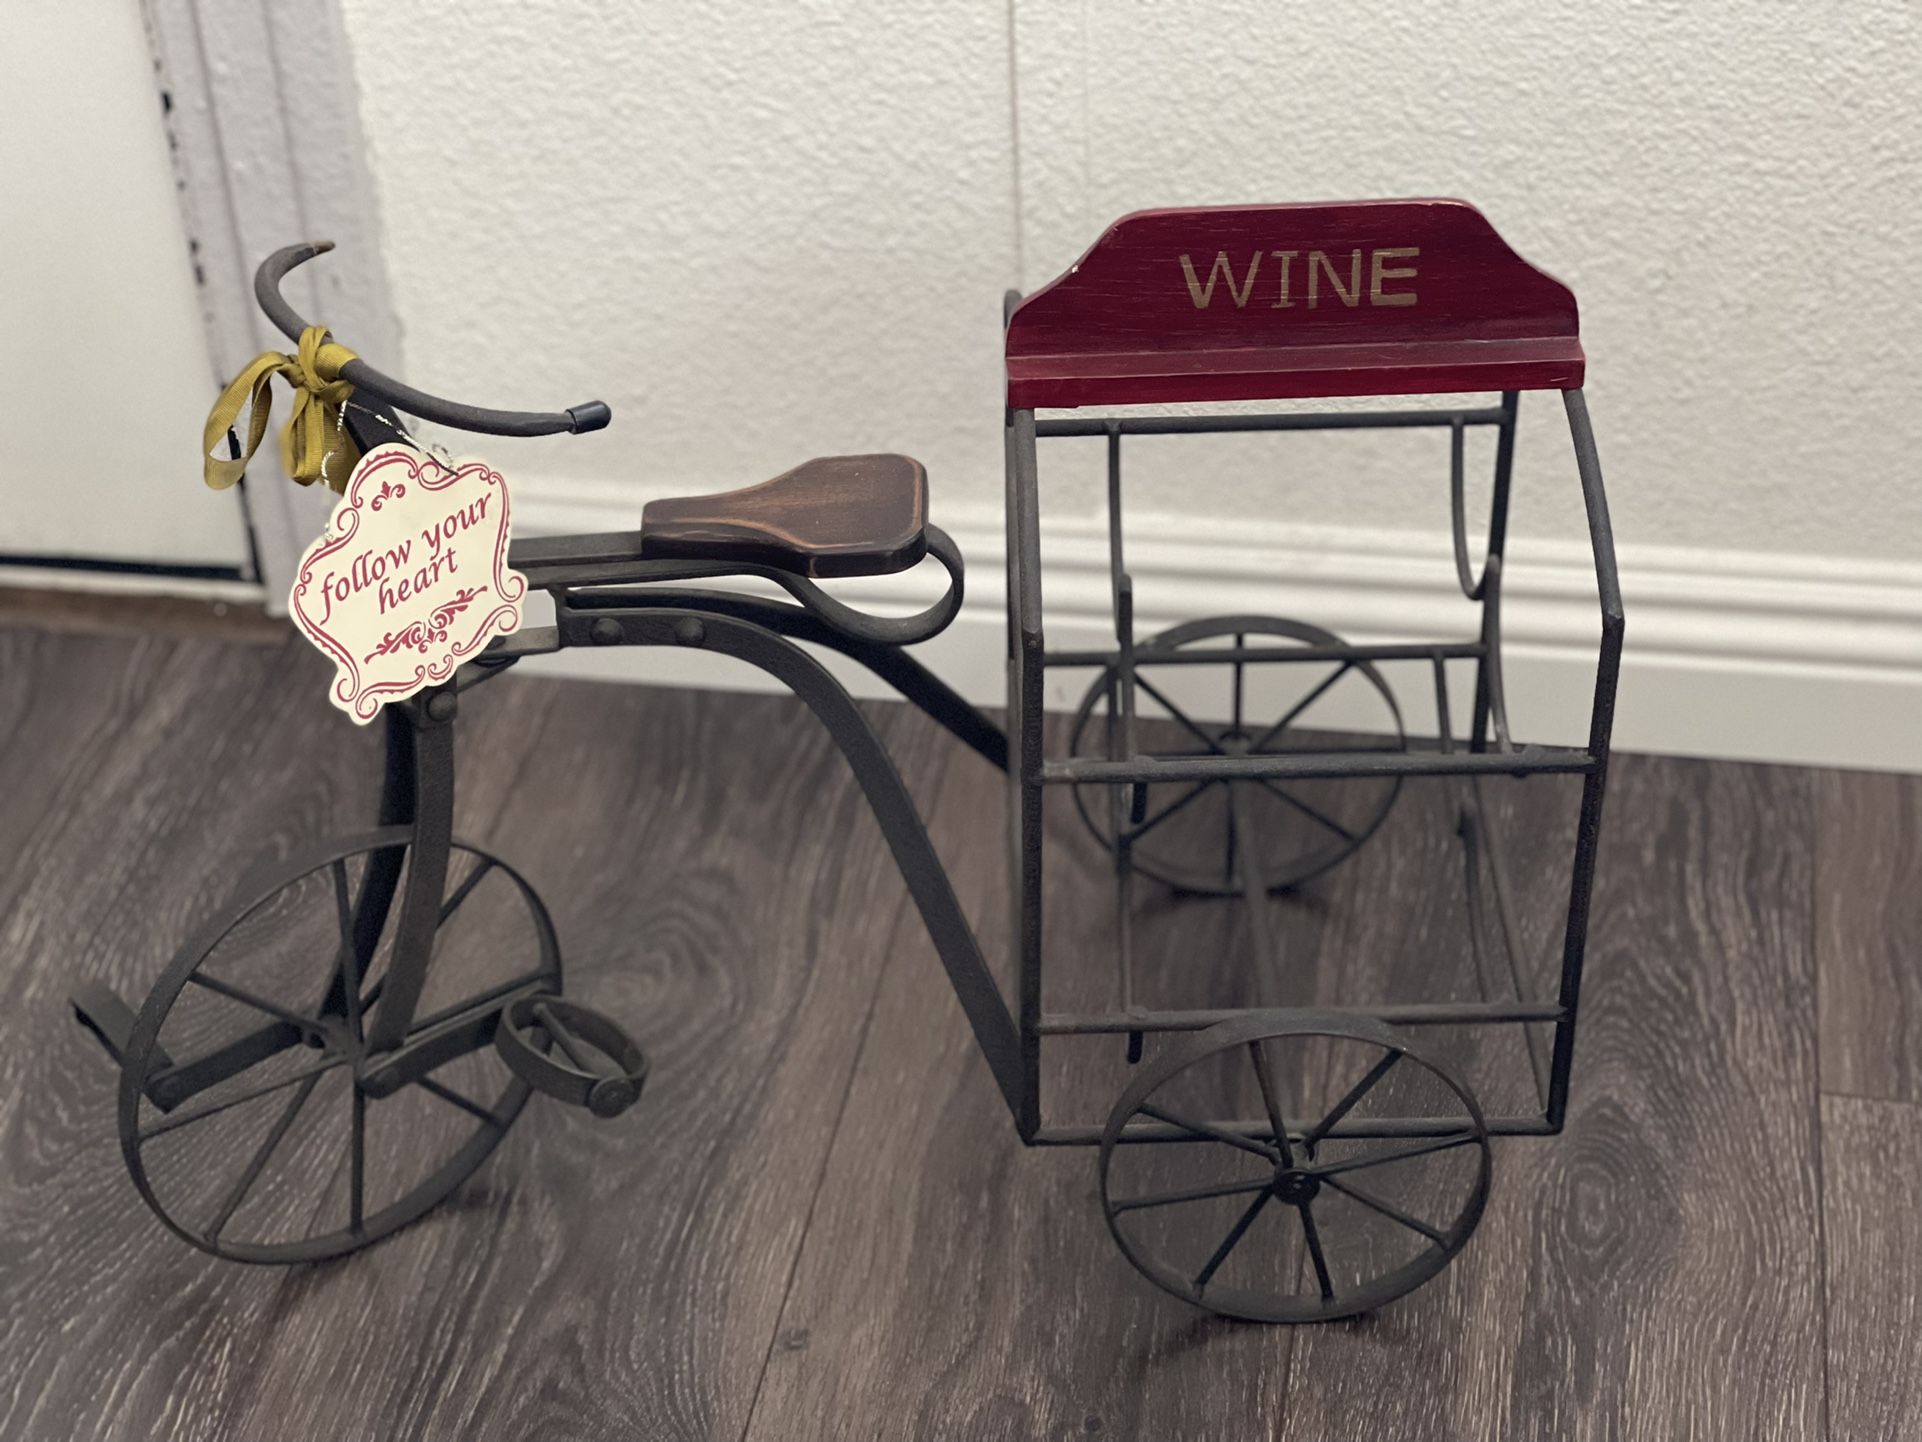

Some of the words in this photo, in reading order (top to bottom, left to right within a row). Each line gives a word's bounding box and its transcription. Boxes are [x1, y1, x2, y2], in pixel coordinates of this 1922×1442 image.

[1178, 247, 1420, 309] WINE
[319, 539, 412, 626] follow
[421, 492, 492, 561] your
[377, 547, 458, 615] heart
